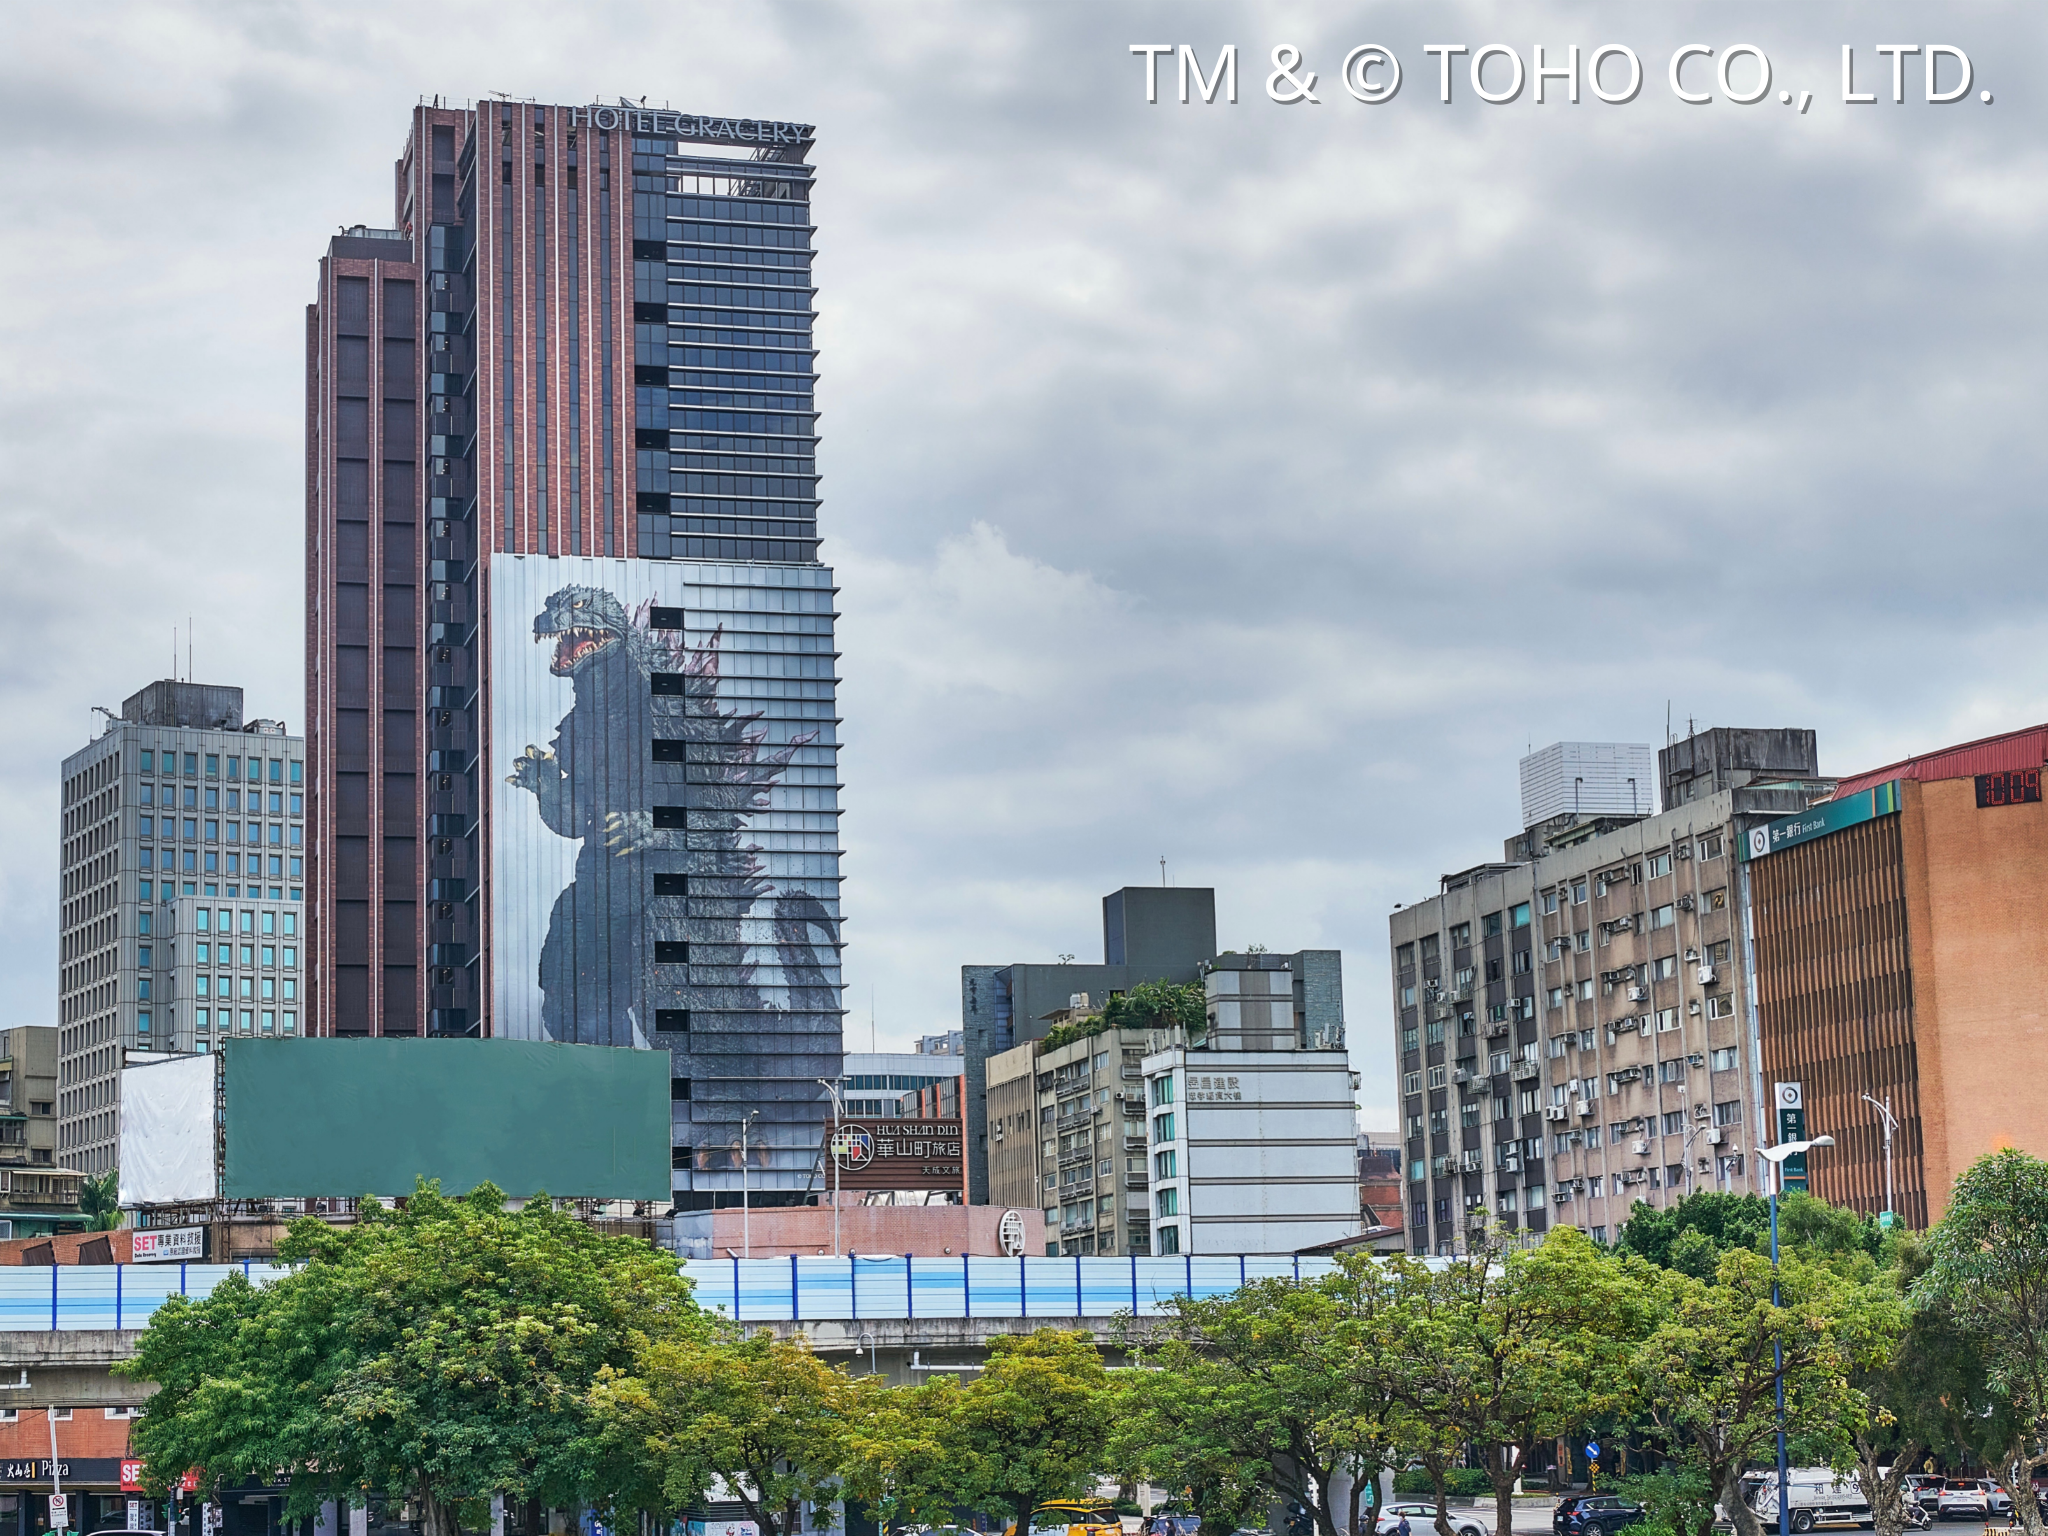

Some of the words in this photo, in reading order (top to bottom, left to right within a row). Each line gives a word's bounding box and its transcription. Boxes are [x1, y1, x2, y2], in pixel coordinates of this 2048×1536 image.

[572, 106, 666, 134] HOTEL
[674, 113, 806, 144] GRACERY
[1772, 822, 1801, 843] 第一銀行
[1802, 823, 1813, 834] First
[1813, 817, 1826, 830] Bank
[876, 1125, 900, 1135] HUA
[876, 1138, 960, 1159] 華山町旅店
[922, 1166, 961, 1175] 天成文旅
[134, 1235, 157, 1252] SET
[158, 1231, 201, 1247] 專業資料救援
